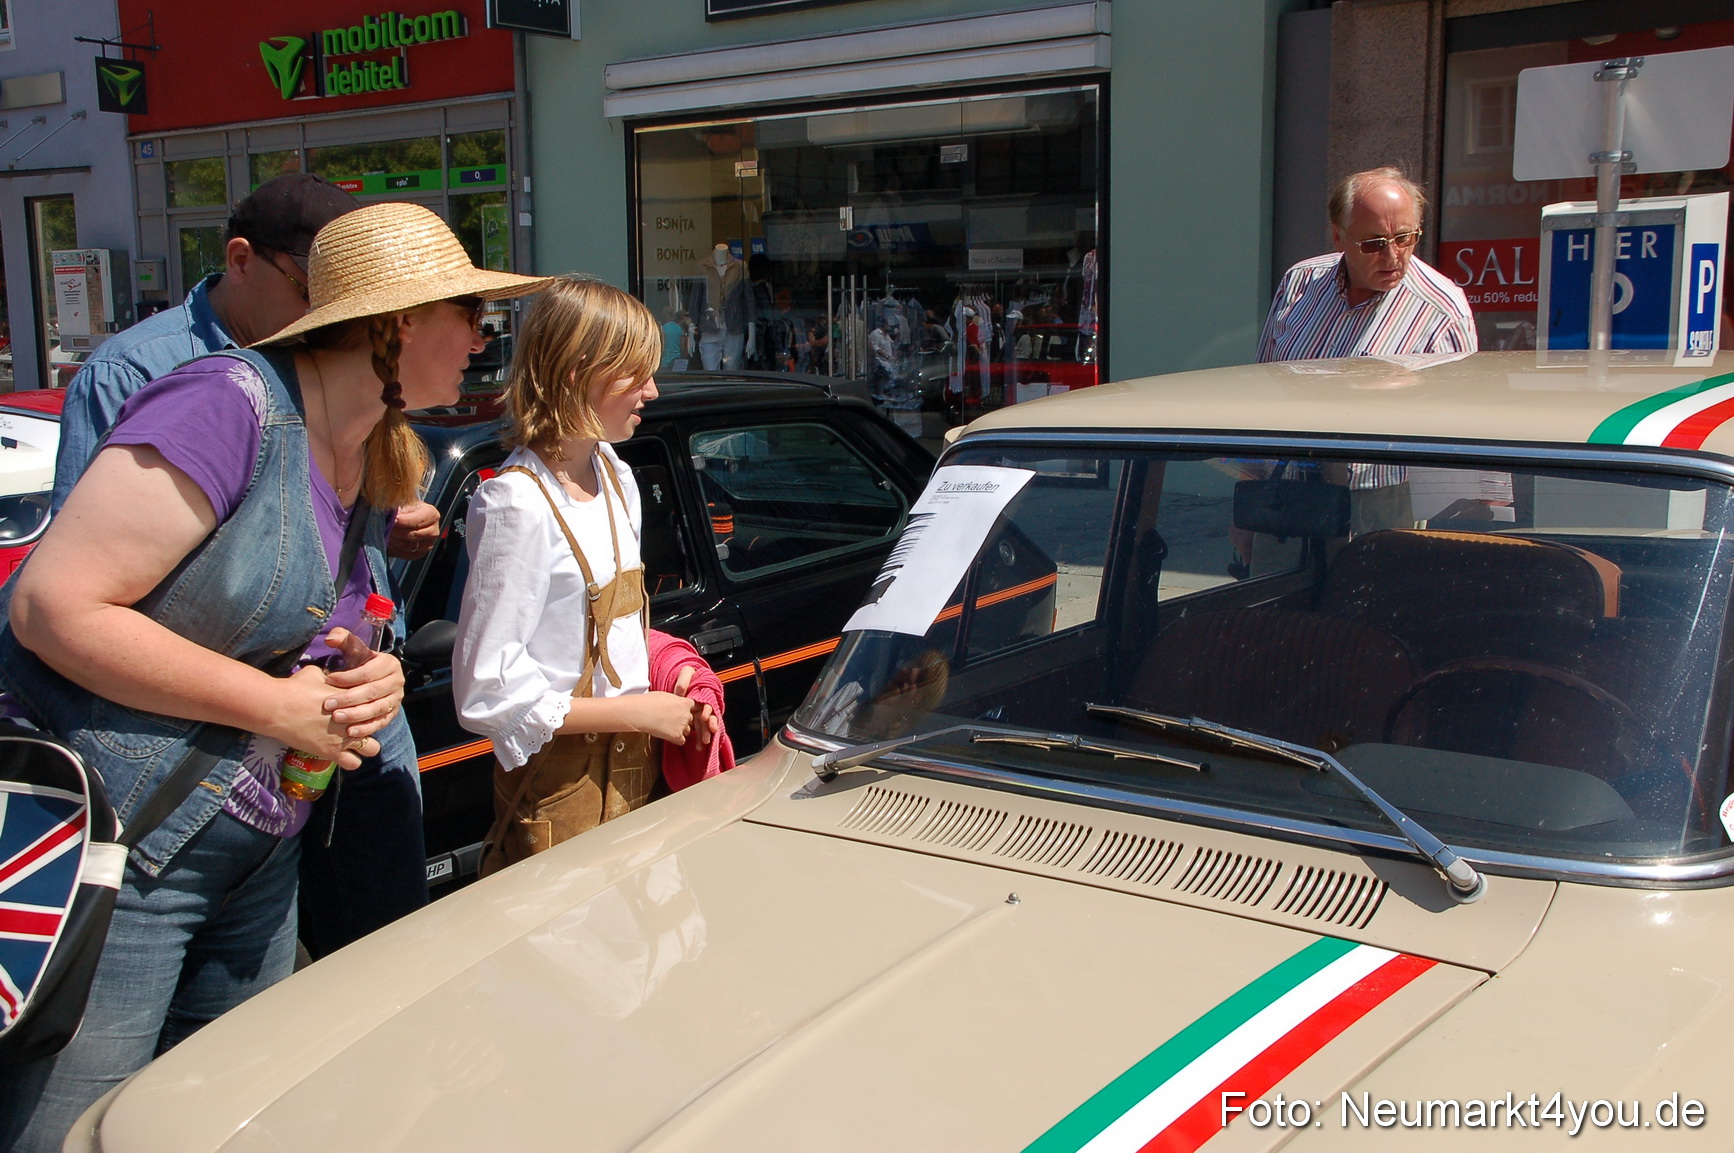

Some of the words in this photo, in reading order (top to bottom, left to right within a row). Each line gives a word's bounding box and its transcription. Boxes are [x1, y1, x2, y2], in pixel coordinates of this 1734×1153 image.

[322, 9, 461, 55] mobilcom
[326, 55, 405, 96] debitel
[142, 144, 152, 155] 45
[656, 216, 695, 234] BONITA
[657, 246, 696, 264] BONITA
[1567, 231, 1658, 262] HER
[1454, 246, 1534, 287] SAL
[1468, 295, 1481, 304] zu
[1484, 291, 1510, 303] 50%
[1514, 290, 1538, 303] redu
[1697, 260, 1715, 314] P
[937, 481, 952, 491] Zu
[952, 481, 1000, 492] verkaufen
